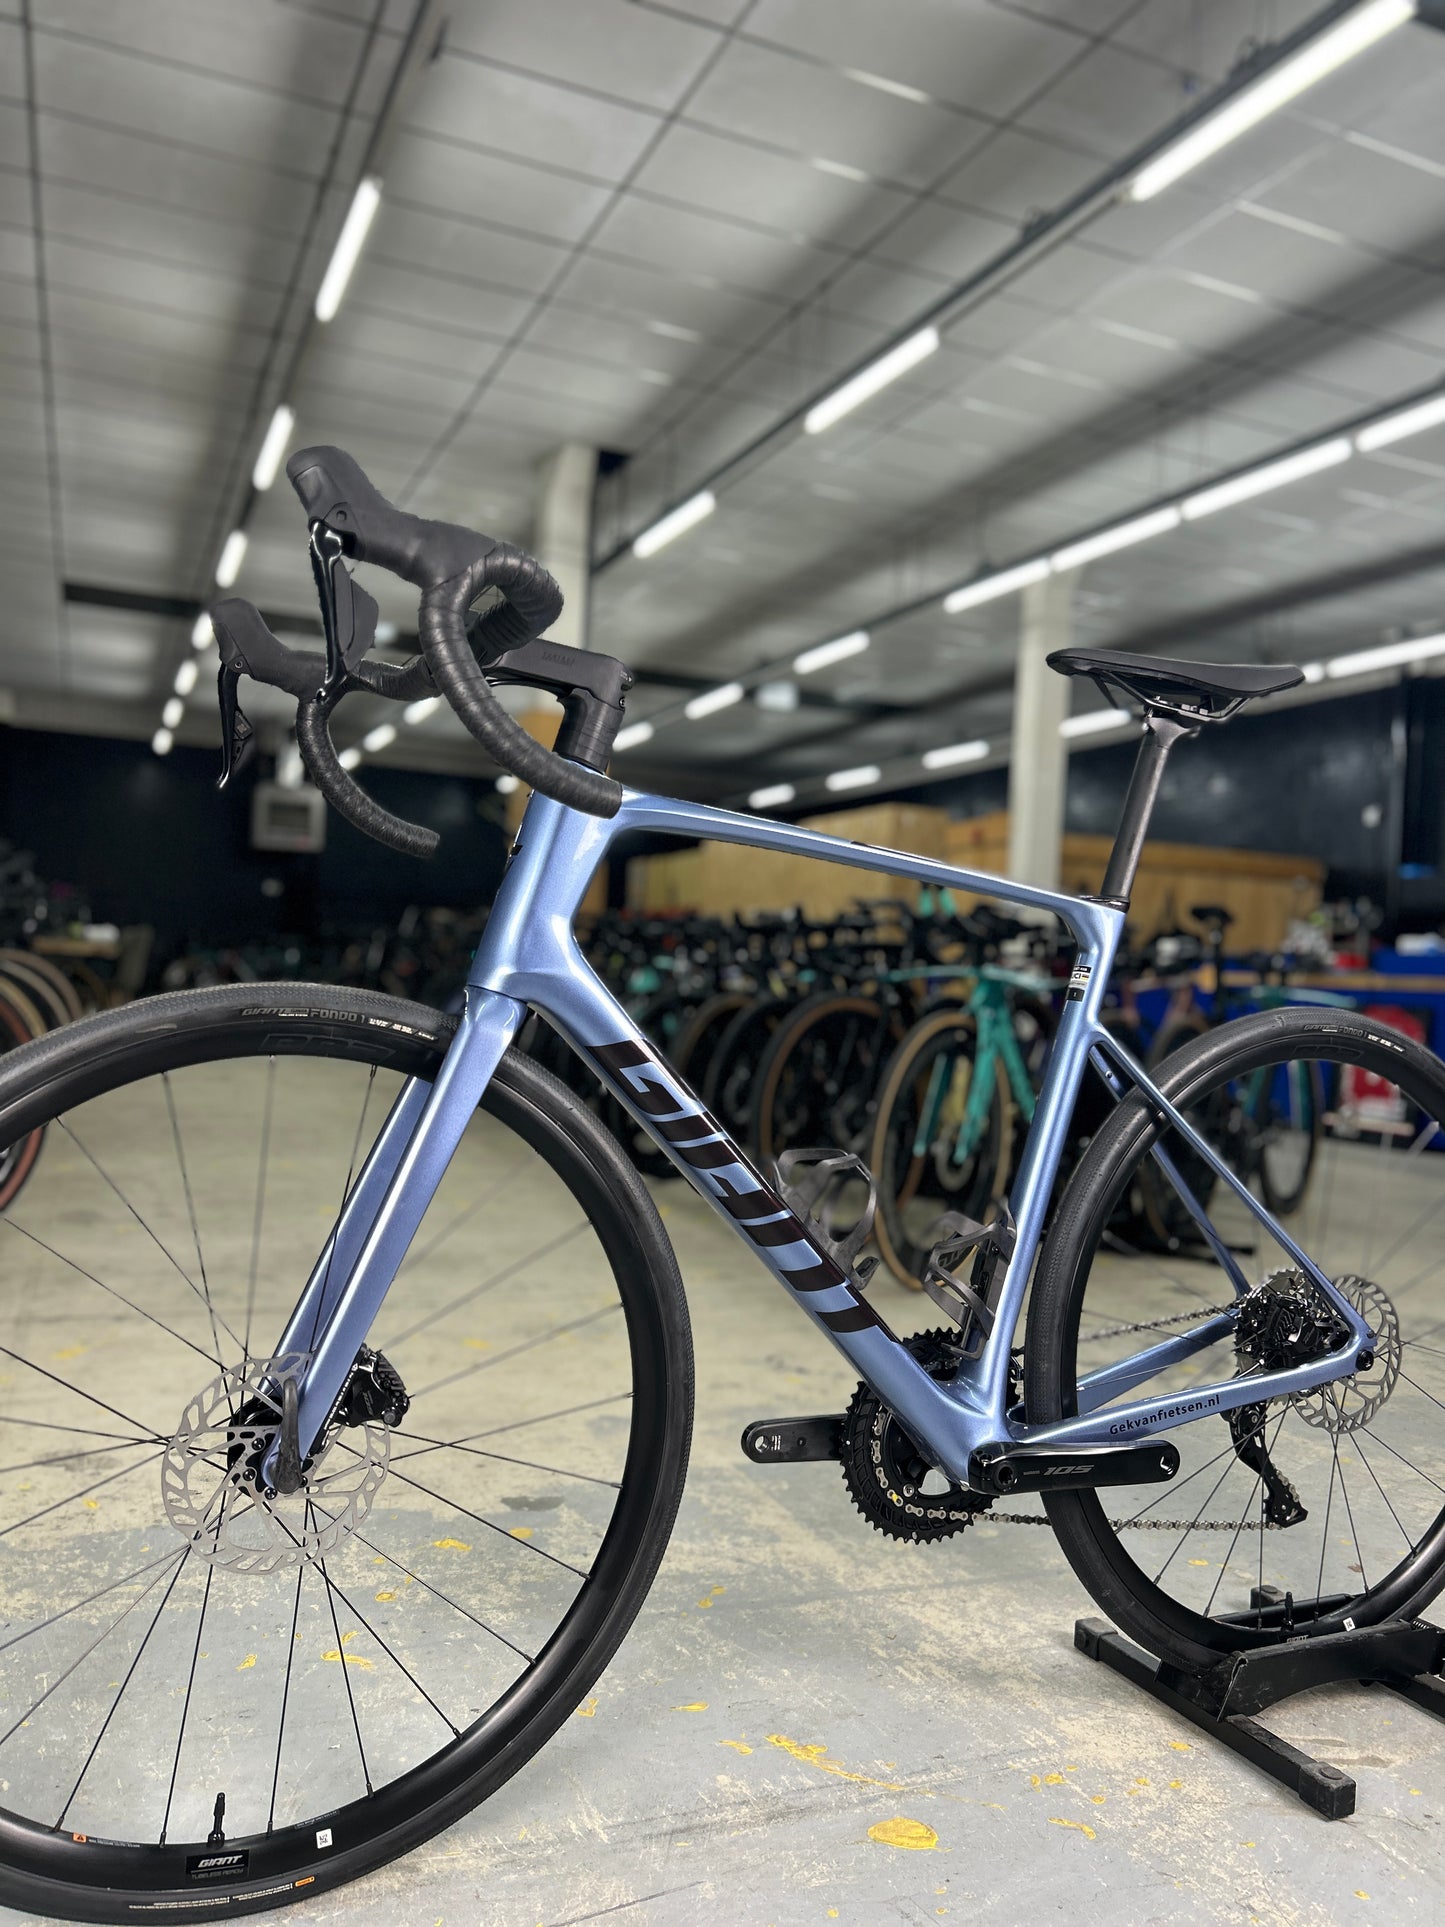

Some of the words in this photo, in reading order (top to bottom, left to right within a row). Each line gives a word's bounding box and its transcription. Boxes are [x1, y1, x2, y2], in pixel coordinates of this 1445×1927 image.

[241, 1007, 288, 1016] GIANT
[310, 1008, 357, 1022] FONDO
[1109, 1394, 1221, 1435] Gekvanfietsen.nl
[1043, 1464, 1095, 1476] 105
[197, 1854, 244, 1868] GIANT
